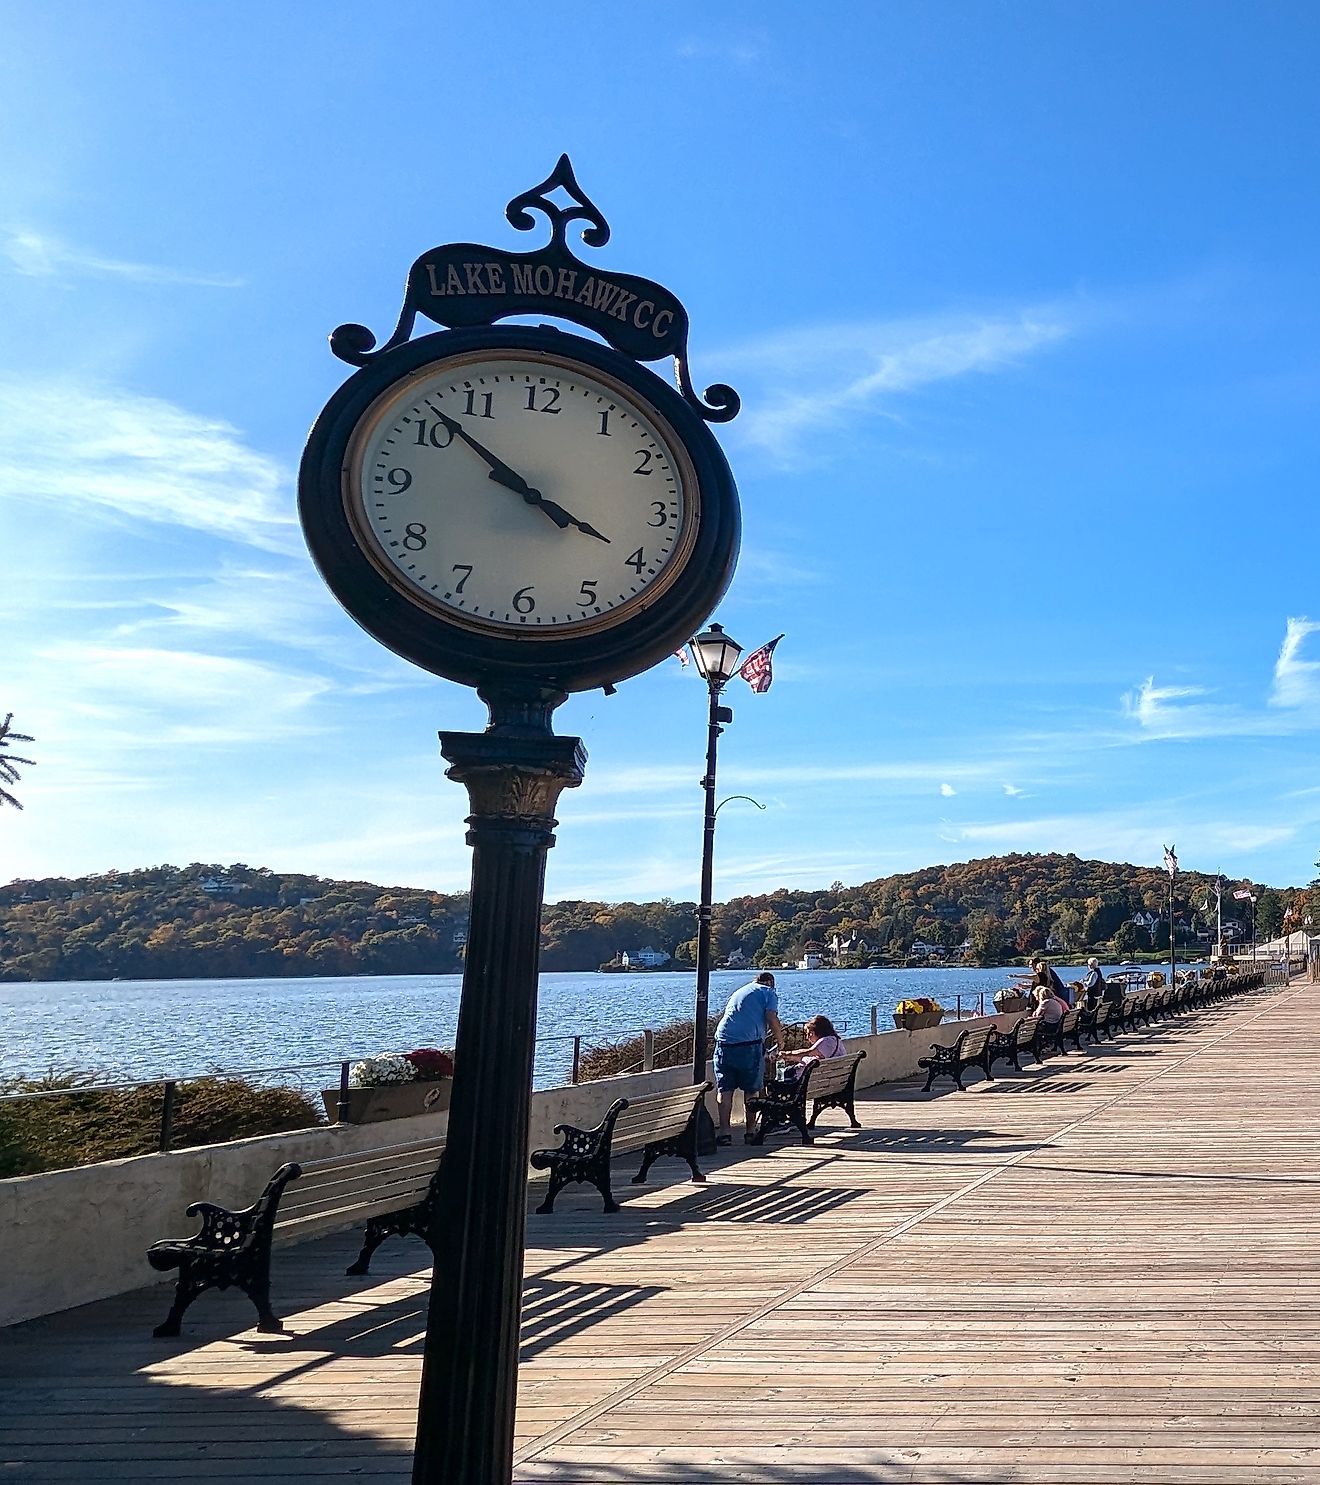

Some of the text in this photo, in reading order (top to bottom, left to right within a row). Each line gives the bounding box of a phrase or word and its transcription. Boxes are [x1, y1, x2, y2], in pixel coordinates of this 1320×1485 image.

[426, 263, 674, 338] LAKE MOHAWK CC
[461, 389, 495, 419] 11
[523, 385, 562, 415] 12
[413, 419, 455, 449] 10
[597, 410, 612, 437] 1
[633, 450, 654, 476] 2
[387, 468, 413, 495] 9
[646, 501, 668, 527] 3
[402, 522, 428, 551] 8
[624, 546, 647, 575] 4
[452, 564, 473, 594] 7
[575, 580, 598, 607] 5
[512, 586, 535, 614] 6
